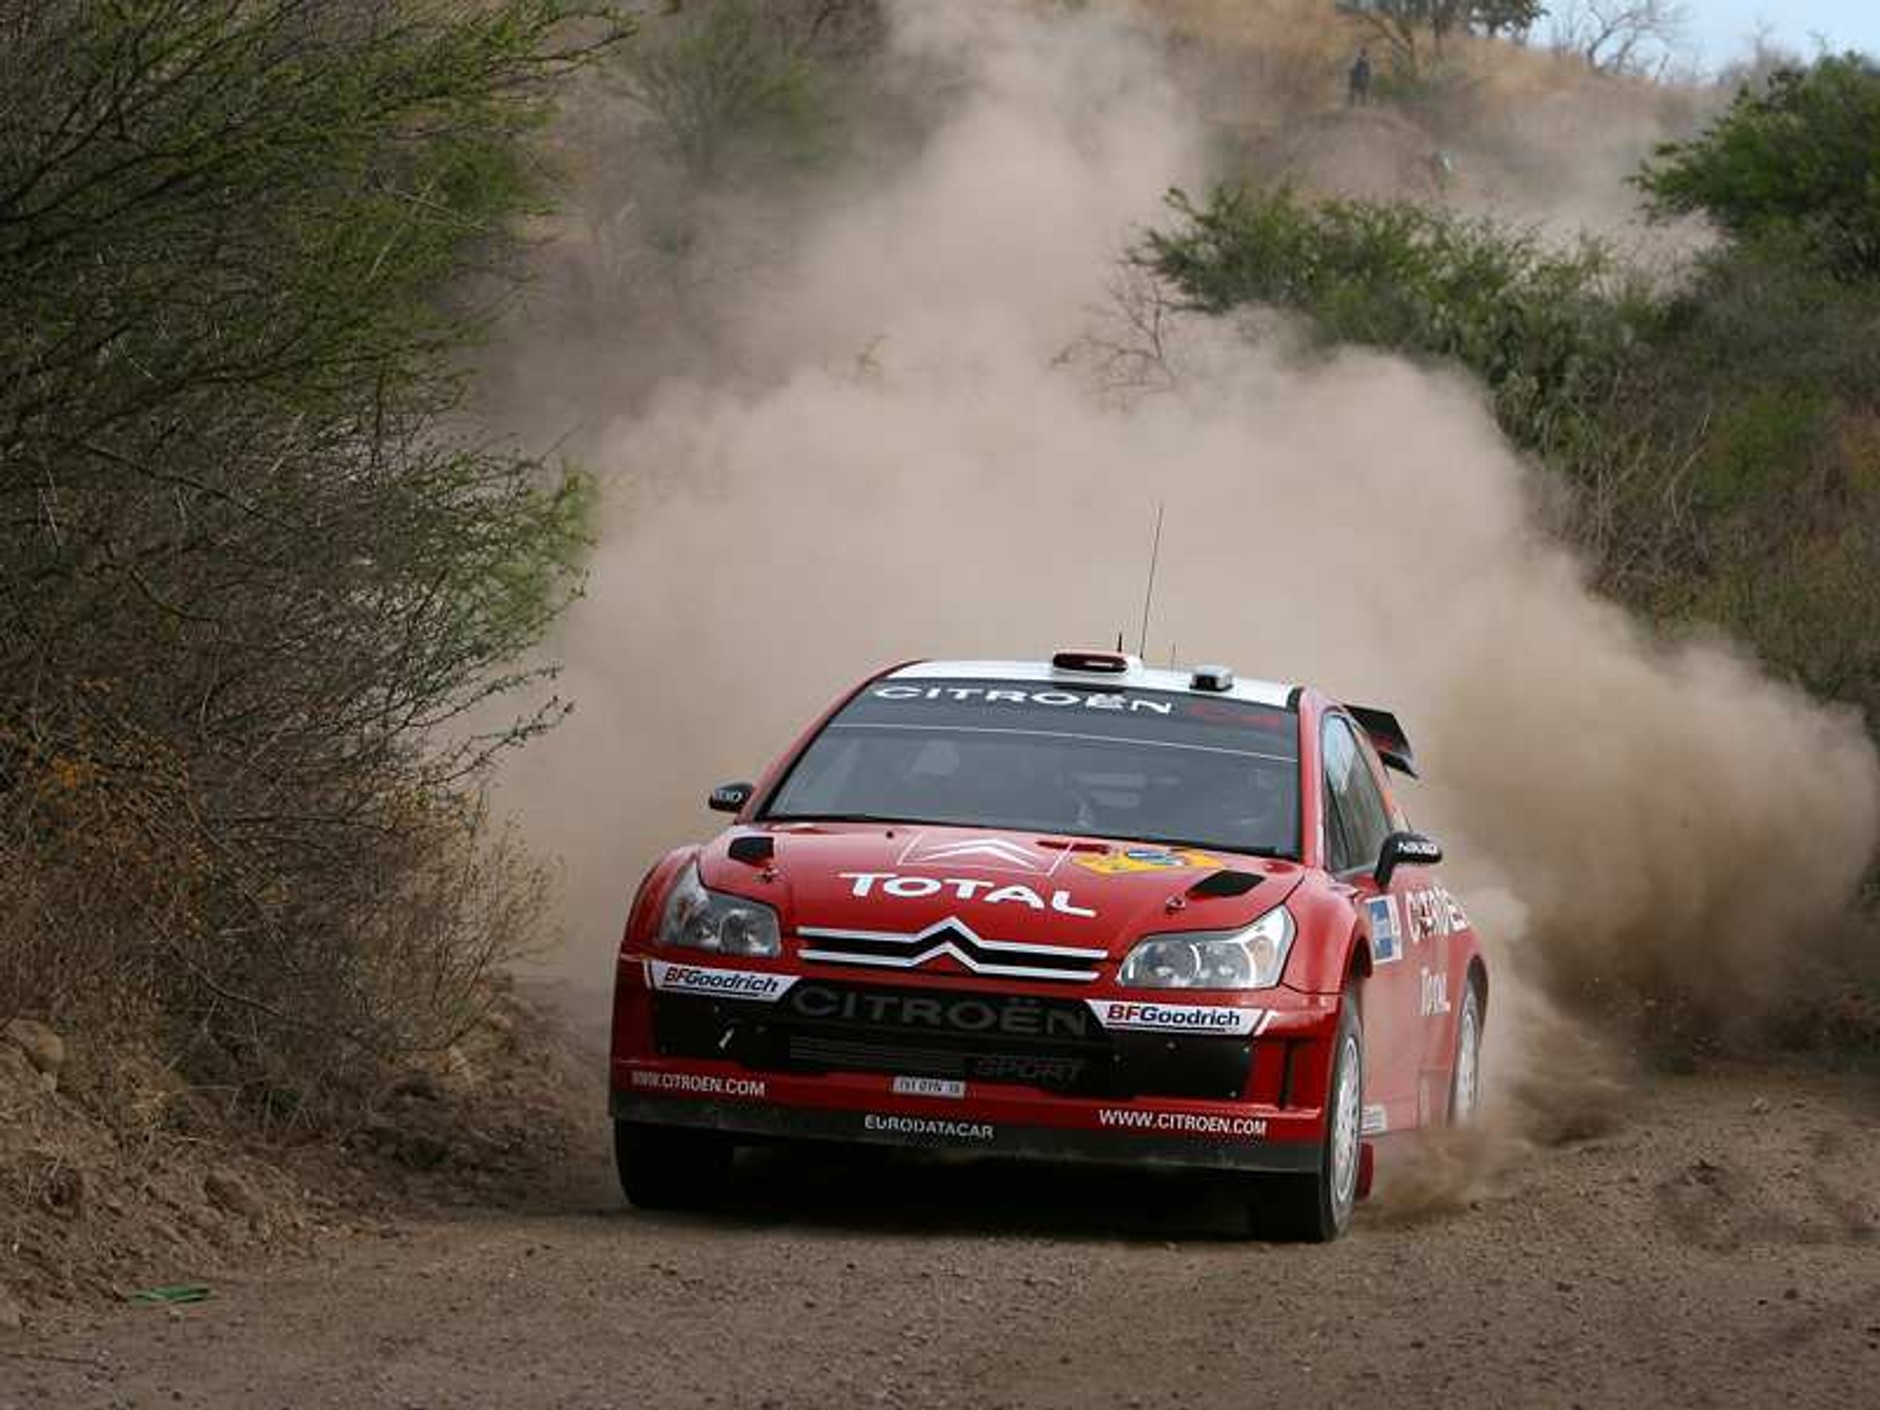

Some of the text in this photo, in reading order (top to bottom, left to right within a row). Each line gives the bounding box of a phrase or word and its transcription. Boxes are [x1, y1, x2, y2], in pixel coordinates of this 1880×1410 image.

[837, 872, 1098, 919] TOTAL
[664, 965, 780, 993] BFGoodrich
[791, 984, 1088, 1036] CITROËN
[1107, 1003, 1241, 1027] BFGoodrich
[864, 1114, 996, 1139] EURODATACAR
[1098, 1108, 1268, 1136] WWW.CITROEN.COM
